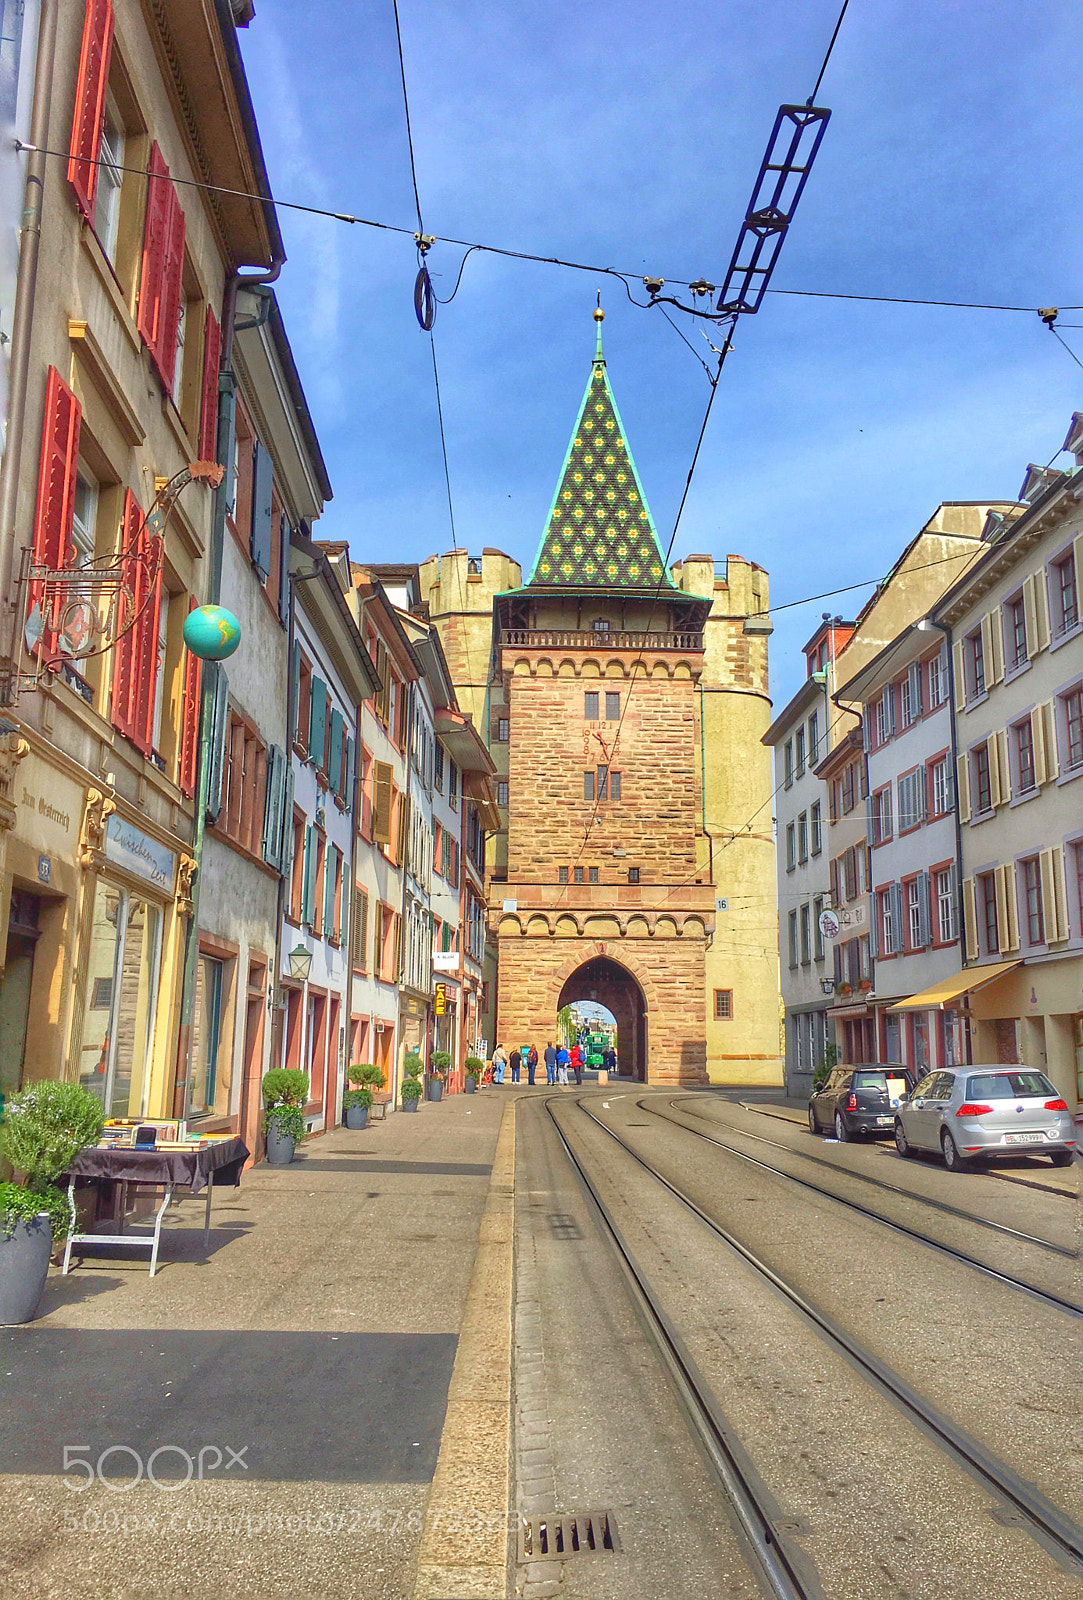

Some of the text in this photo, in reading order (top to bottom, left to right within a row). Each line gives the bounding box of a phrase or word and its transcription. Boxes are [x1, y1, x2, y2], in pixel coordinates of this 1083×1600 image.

[583, 746, 589, 754] 8
[591, 753, 596, 762] 7
[599, 753, 605, 761] 6
[40, 861, 49, 876] 33
[717, 899, 727, 910] 16
[436, 984, 445, 1014] CAFE
